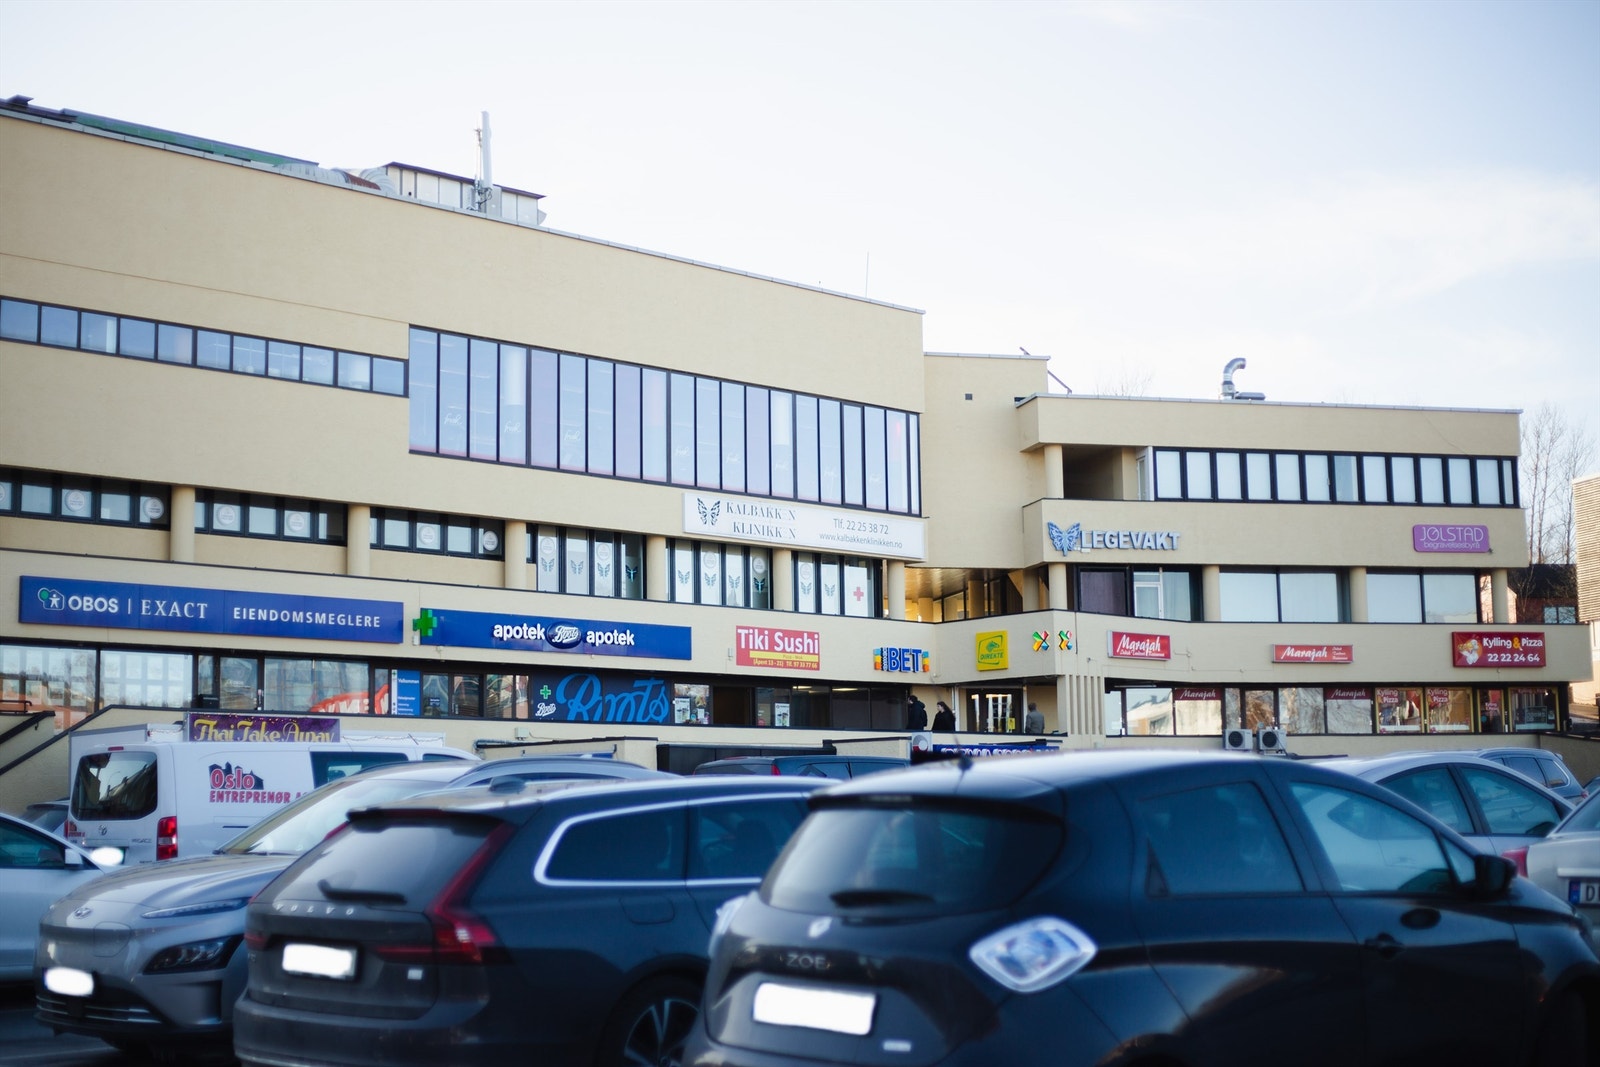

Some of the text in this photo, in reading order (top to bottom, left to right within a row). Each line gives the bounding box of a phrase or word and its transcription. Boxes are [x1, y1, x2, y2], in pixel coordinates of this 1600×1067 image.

[846, 520, 856, 531] 22
[858, 521, 867, 532] 25
[868, 523, 878, 534] 38
[879, 524, 889, 535] 72
[1420, 526, 1484, 542] JØLSTAD
[1080, 530, 1180, 550] LEGEVAKT
[68, 595, 381, 628] OBOS EXACT EIENDOMSMEGLERE
[493, 623, 635, 647] apotek Boots apotek
[737, 628, 819, 655] Tiki Sushi
[1483, 637, 1512, 649] Kylling
[1521, 637, 1543, 647] Pizza
[1116, 634, 1161, 656] Marajah
[887, 647, 922, 672] BET
[1280, 646, 1327, 661] Marajah
[1487, 653, 1540, 662] 22 22 24 64
[1180, 689, 1216, 700] Marajah
[1331, 688, 1366, 699] Marajah
[535, 702, 556, 717] Boots
[193, 718, 235, 742] Thai
[237, 720, 281, 742] Take
[210, 768, 255, 790] Oslo
[209, 790, 291, 804] ENTREPRENØR
[276, 903, 354, 916] VOLVO
[787, 954, 826, 970] ZOE
